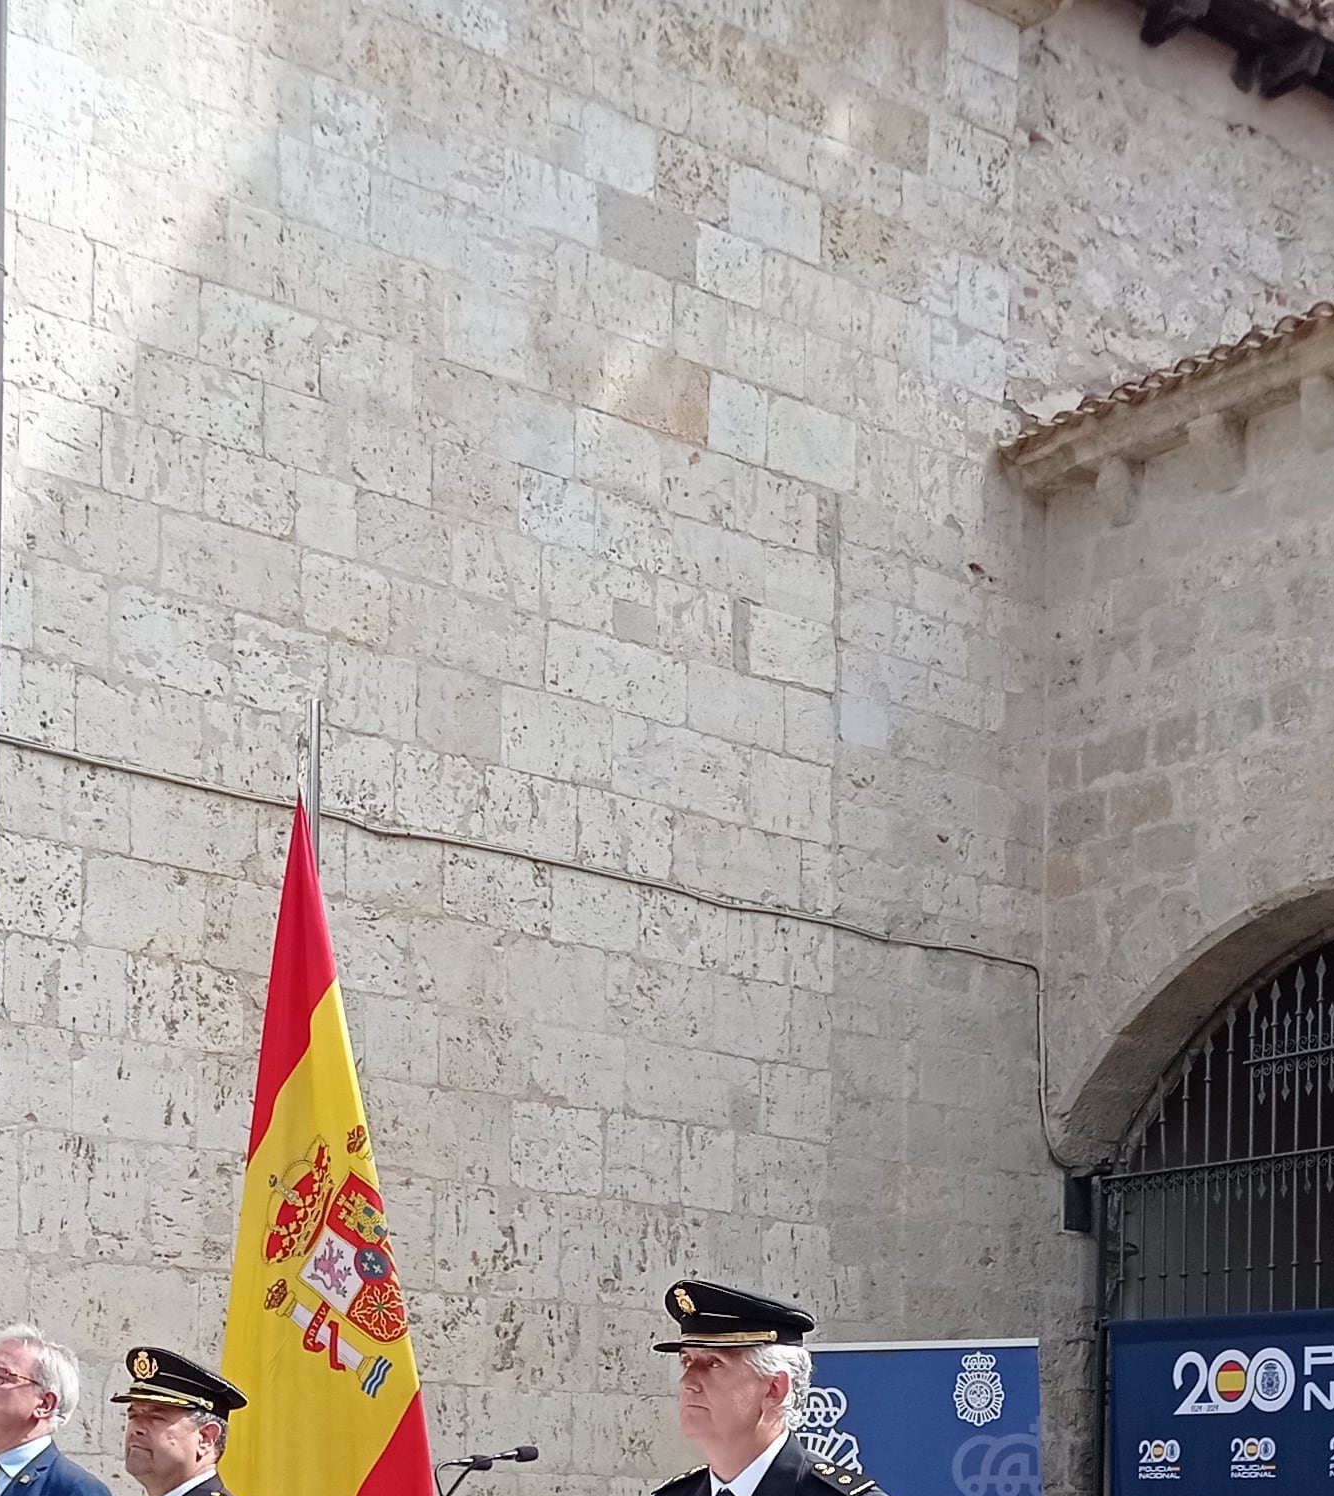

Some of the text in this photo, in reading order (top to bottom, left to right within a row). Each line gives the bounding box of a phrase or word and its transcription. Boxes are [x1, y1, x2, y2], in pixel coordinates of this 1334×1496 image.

[1173, 1346, 1295, 1415] 200
[1139, 1440, 1180, 1463] 200
[1231, 1437, 1275, 1461] 200
